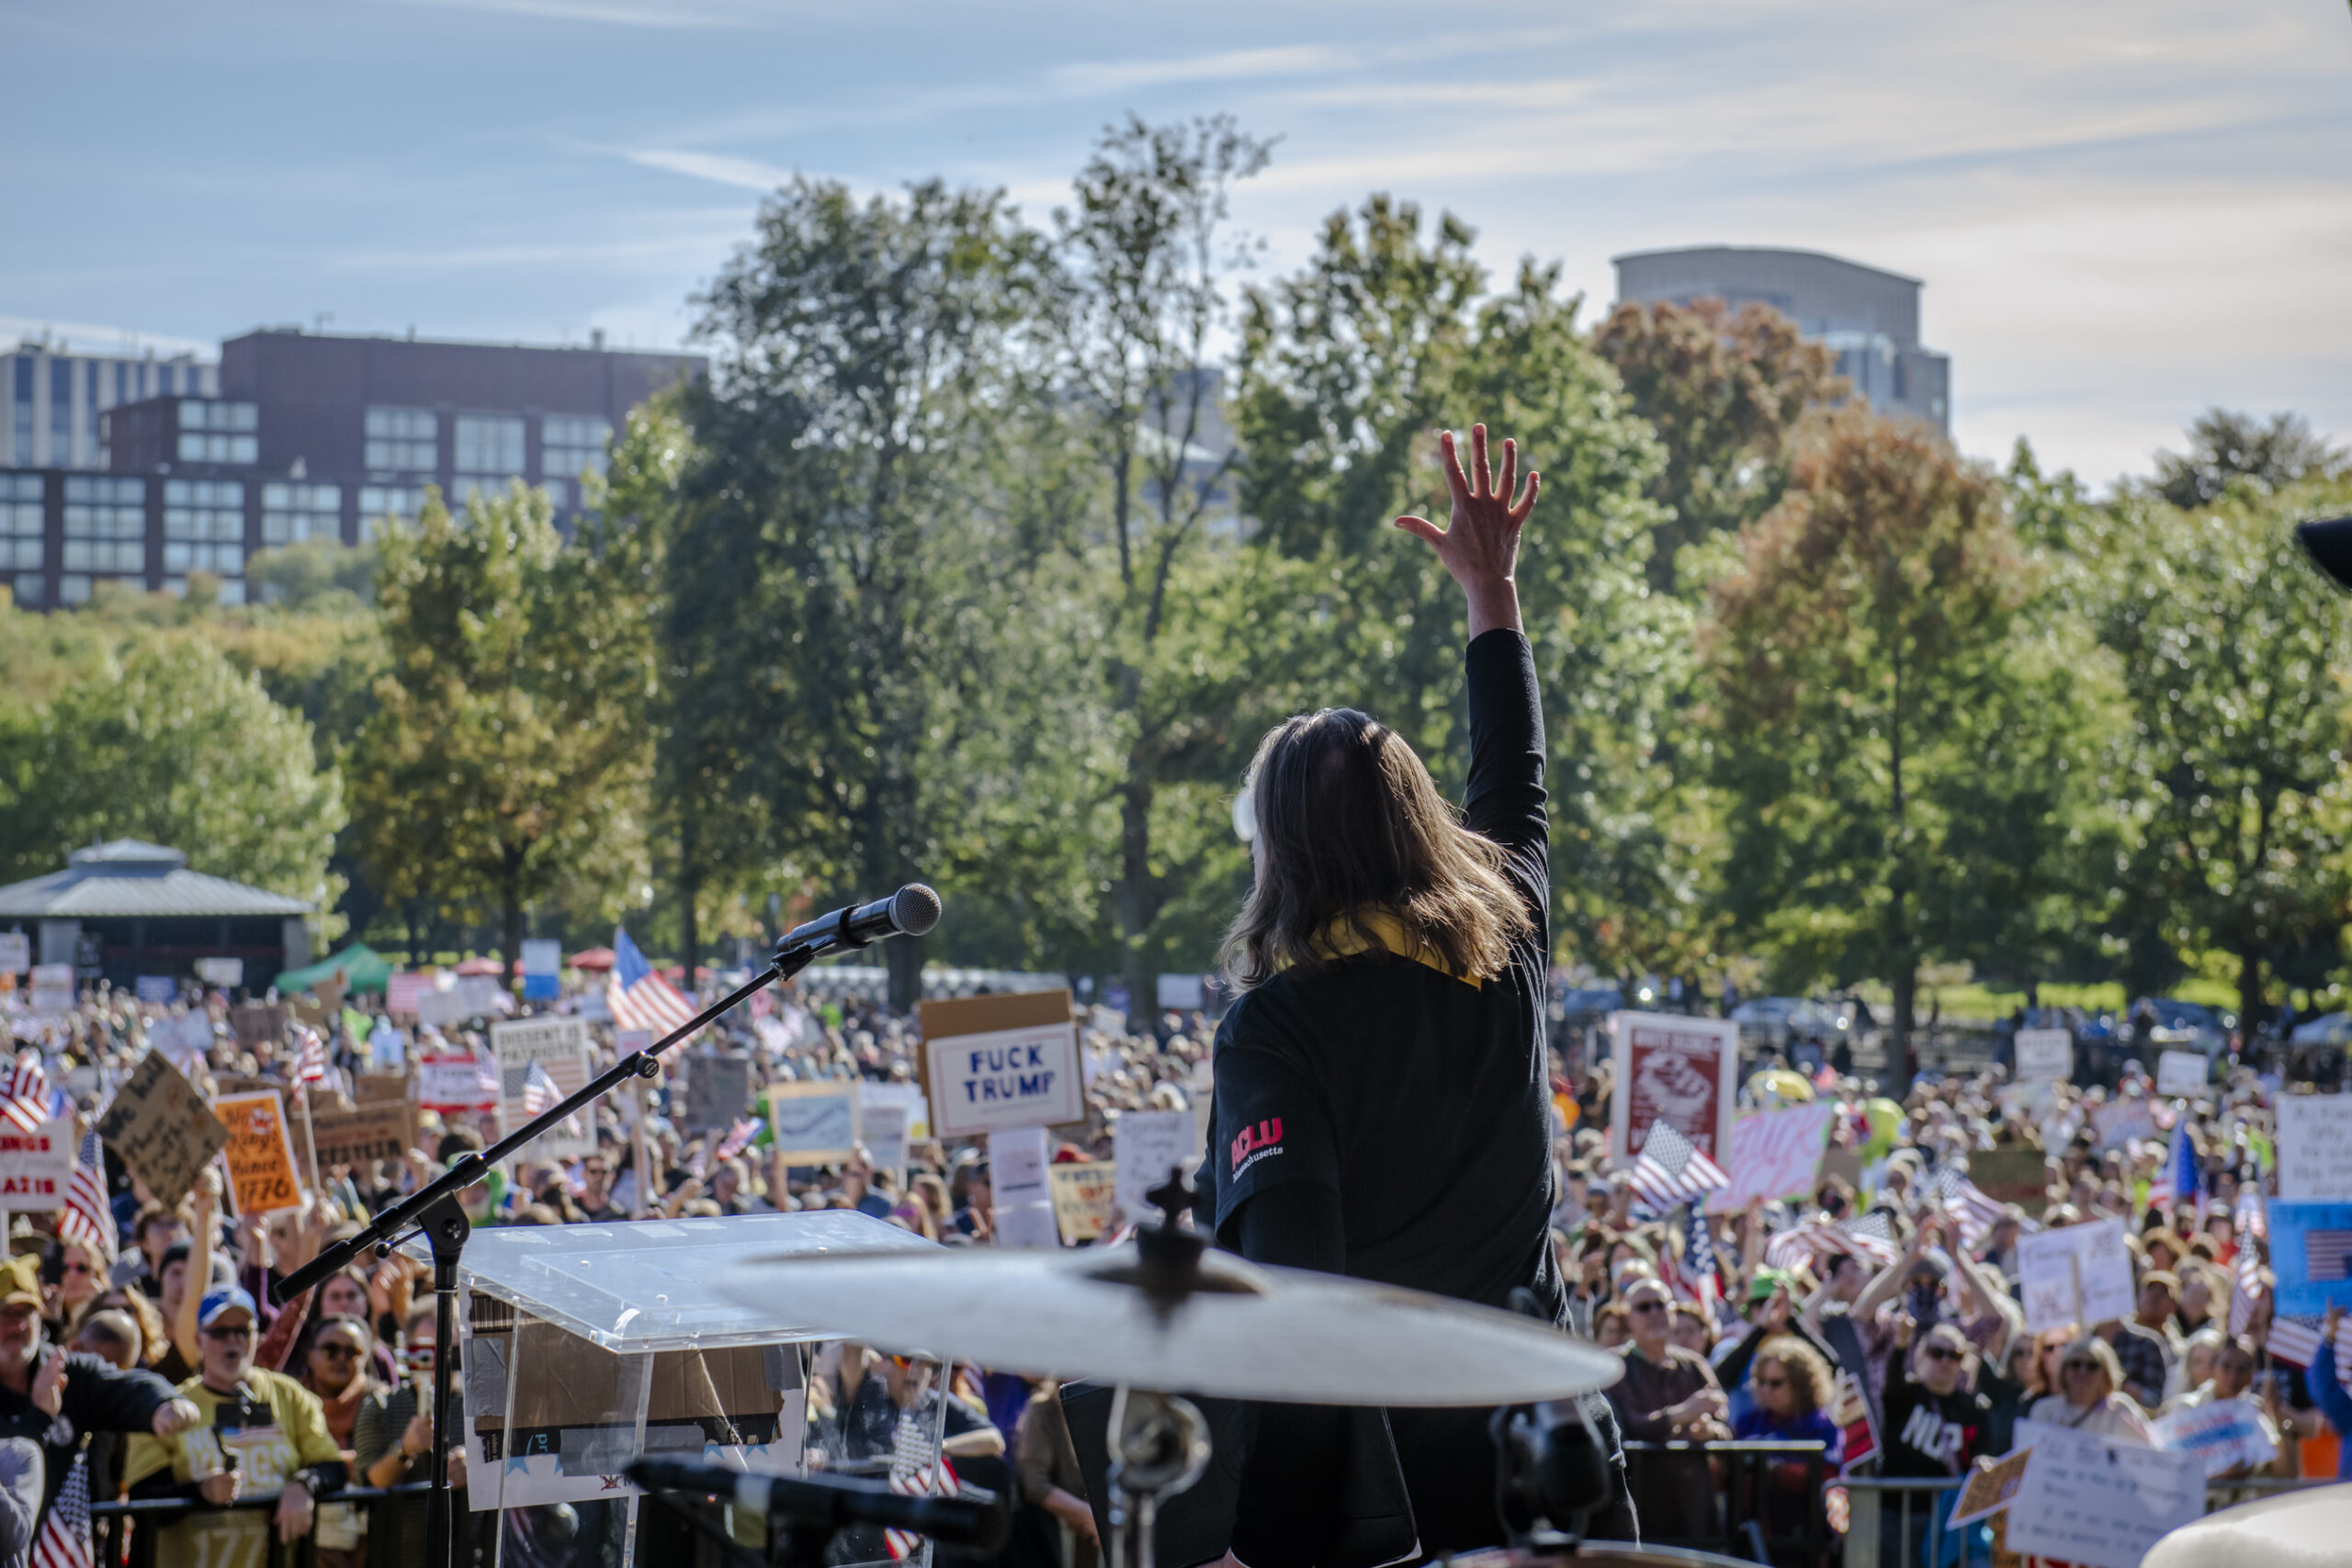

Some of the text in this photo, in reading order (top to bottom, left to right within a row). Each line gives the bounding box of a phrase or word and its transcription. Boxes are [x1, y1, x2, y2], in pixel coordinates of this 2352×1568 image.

[500, 1023, 580, 1045] DISSENT IS
[970, 1044, 1043, 1074] FUCK
[964, 1071, 1055, 1103] TRUMP
[0, 1135, 51, 1151] INGS
[1231, 1117, 1283, 1171] ACLU
[1233, 1145, 1283, 1184] Massachusetts
[0, 1176, 55, 1194] AZIS
[240, 1177, 290, 1205] 1776
[535, 1433, 548, 1454] pr
